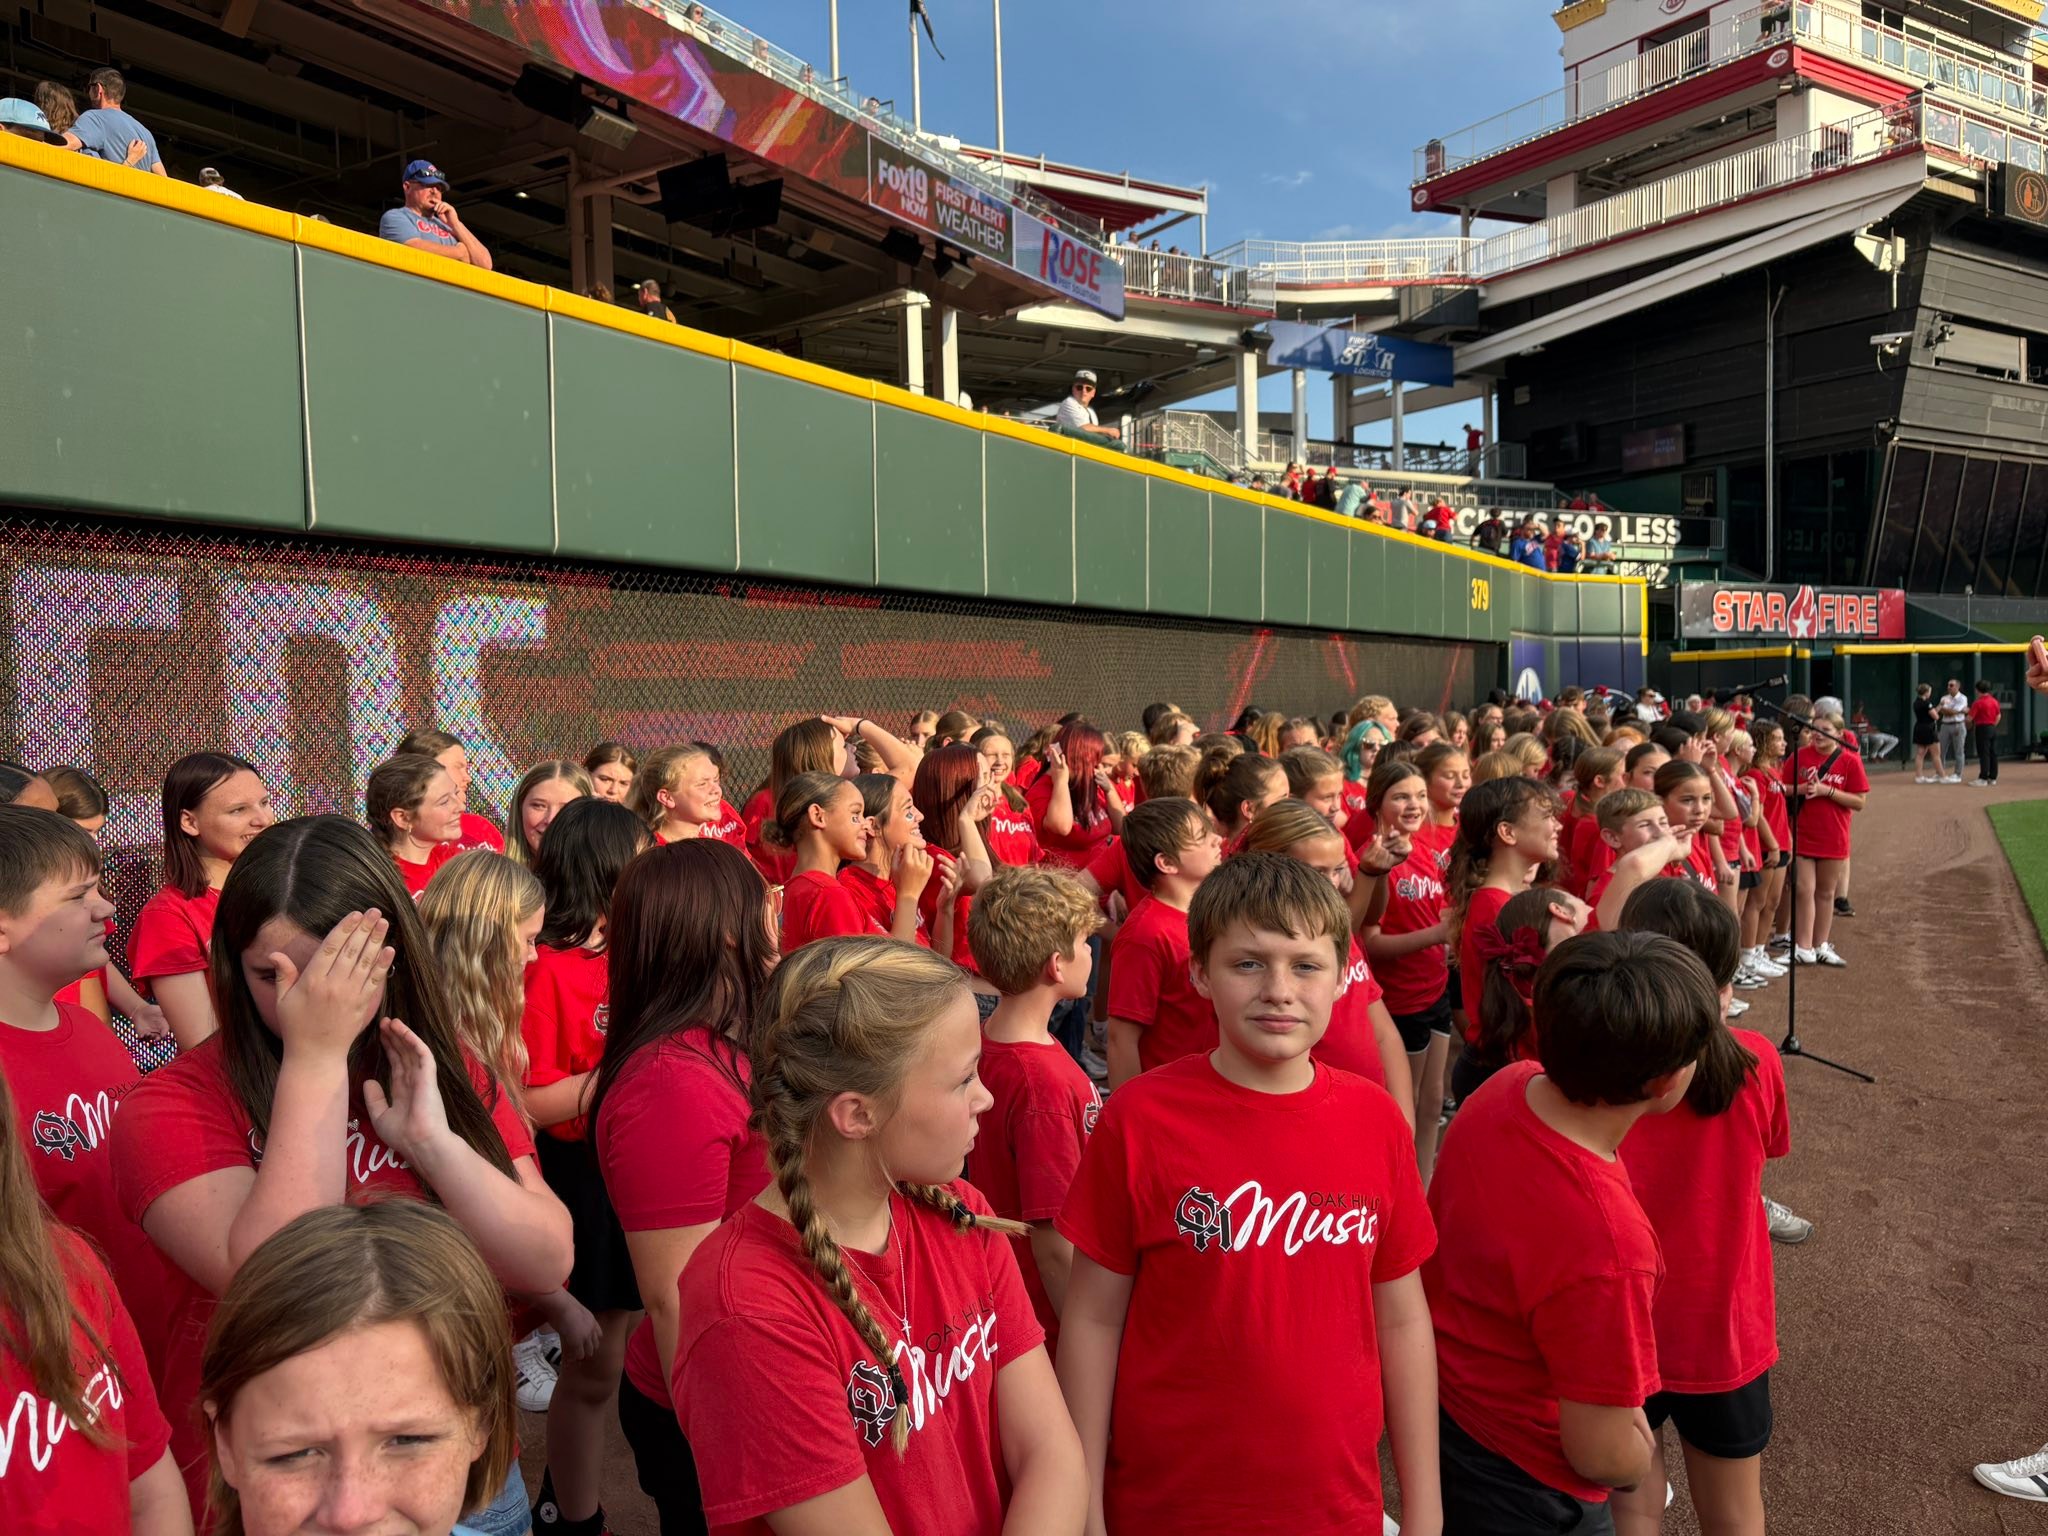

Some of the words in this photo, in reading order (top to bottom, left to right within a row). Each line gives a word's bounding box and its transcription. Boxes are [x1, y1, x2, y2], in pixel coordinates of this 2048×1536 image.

[878, 157, 928, 204] FOX19
[901, 196, 929, 219] NOW
[935, 181, 967, 213] FIRST
[969, 195, 1006, 233] ALERT
[935, 201, 1005, 252] WEATHER
[1040, 229, 1101, 291] ROSE
[1618, 516, 1682, 545] LESS
[1471, 577, 1489, 611] 379
[1713, 590, 1787, 632] STAR
[1818, 594, 1878, 634] FIRE
[1308, 1190, 1347, 1209] OAK
